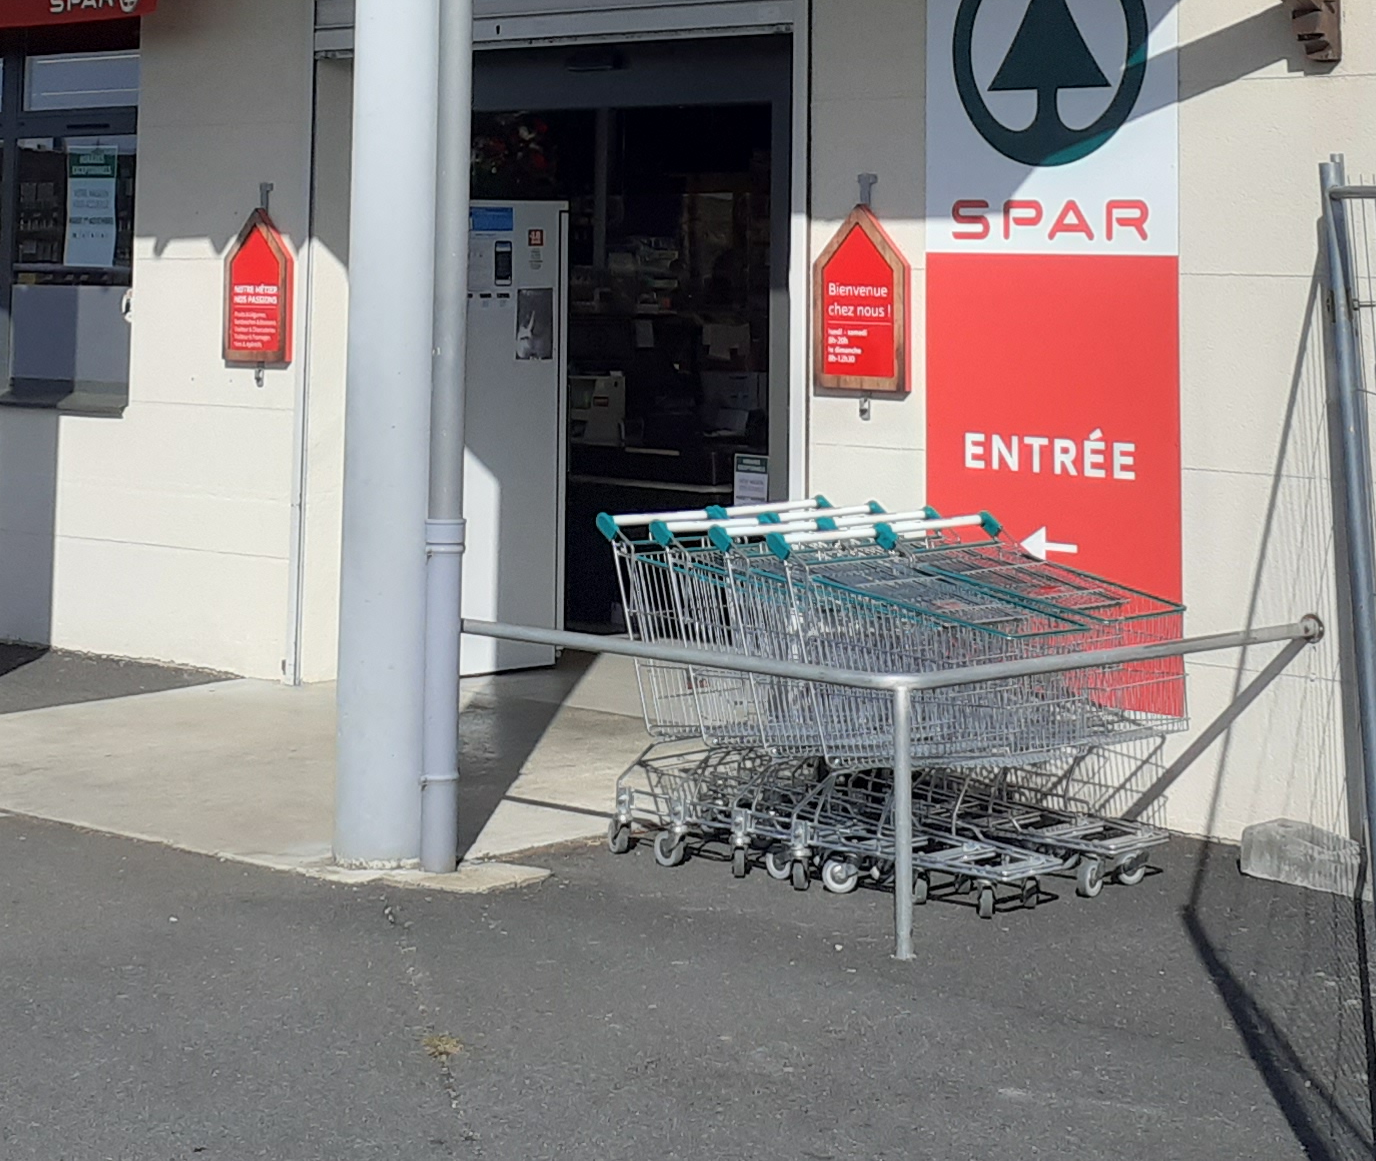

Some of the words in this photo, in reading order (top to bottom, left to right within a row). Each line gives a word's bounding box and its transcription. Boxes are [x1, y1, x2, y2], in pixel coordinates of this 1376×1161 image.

[951, 199, 1149, 241] SPAR
[828, 282, 888, 297] Bienvenue
[828, 302, 854, 316] chez
[857, 306, 885, 317] nous
[964, 427, 1136, 481] ENTRÉE
